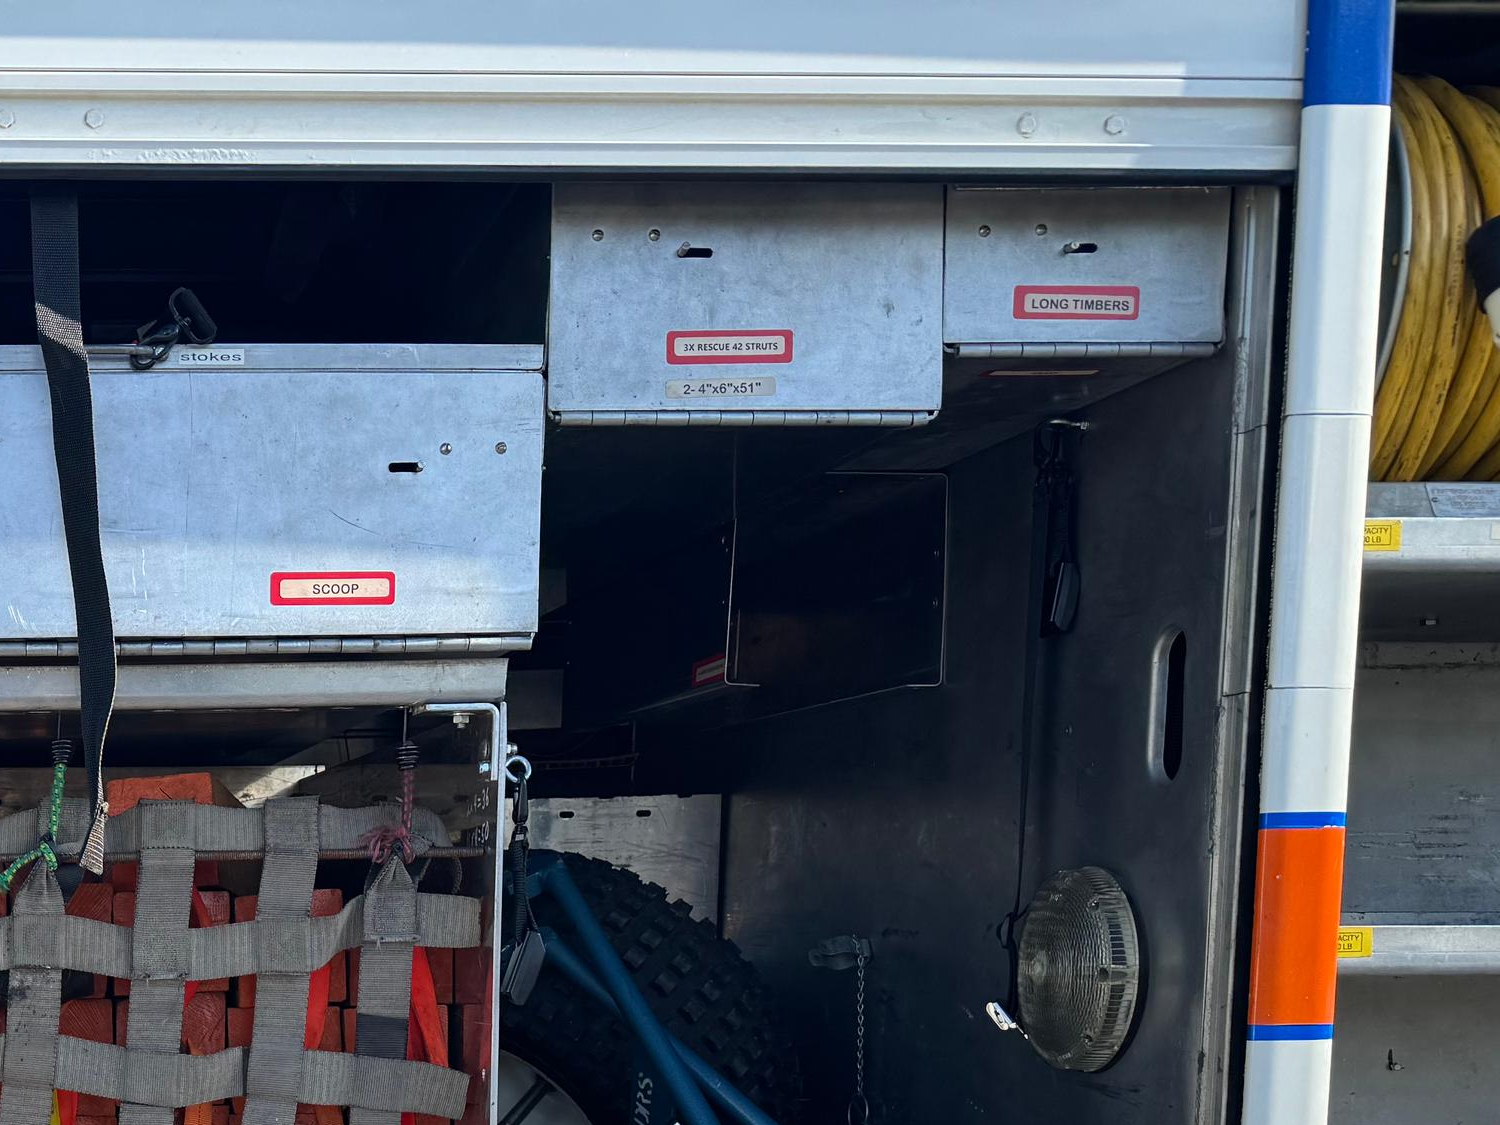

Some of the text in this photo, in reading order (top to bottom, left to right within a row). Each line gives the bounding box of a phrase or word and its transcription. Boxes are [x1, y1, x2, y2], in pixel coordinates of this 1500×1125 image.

[1032, 299, 1130, 311] LONG TIMBERS
[684, 342, 778, 352] 3X RESCUE 42 STRUTS
[181, 352, 242, 362] stokes
[698, 382, 762, 394] 4"x6"x51"
[312, 583, 359, 595] SCOOP
